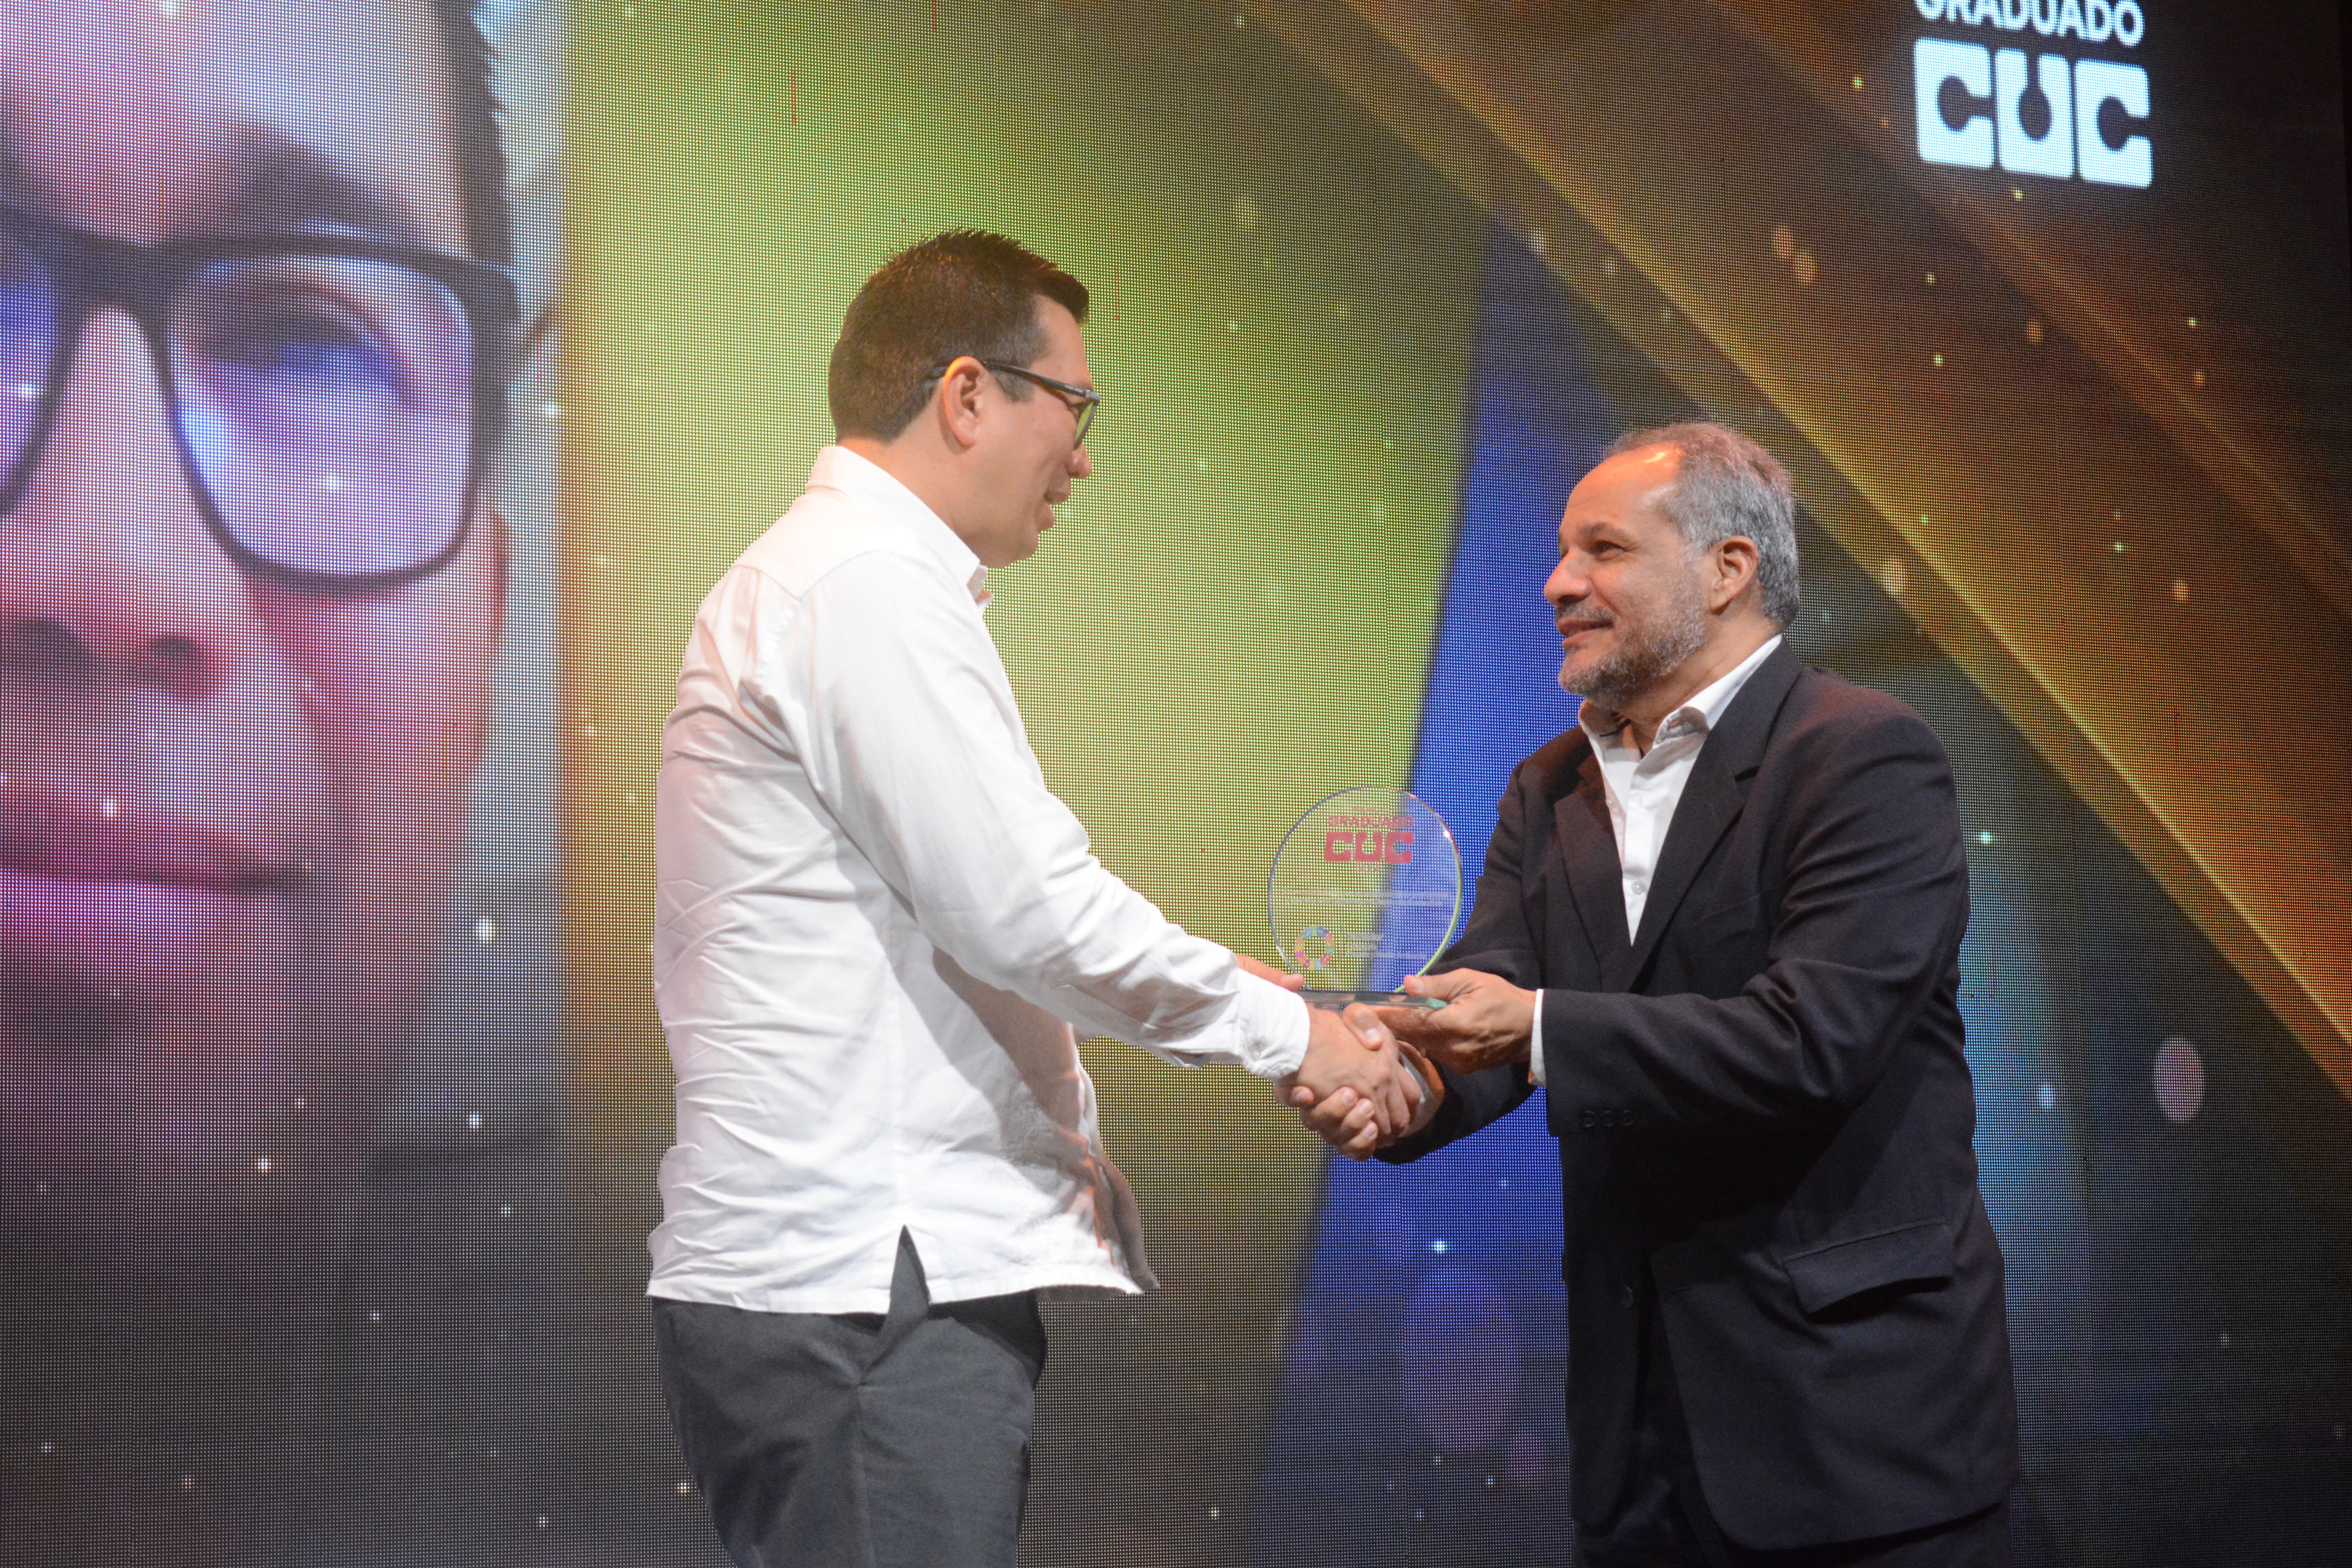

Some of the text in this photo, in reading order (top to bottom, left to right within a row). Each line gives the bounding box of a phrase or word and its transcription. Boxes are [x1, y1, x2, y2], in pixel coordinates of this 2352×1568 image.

[1914, 36, 2154, 189] CUC
[1328, 815, 1414, 829] GRADUADO
[1324, 831, 1414, 864] CUC
